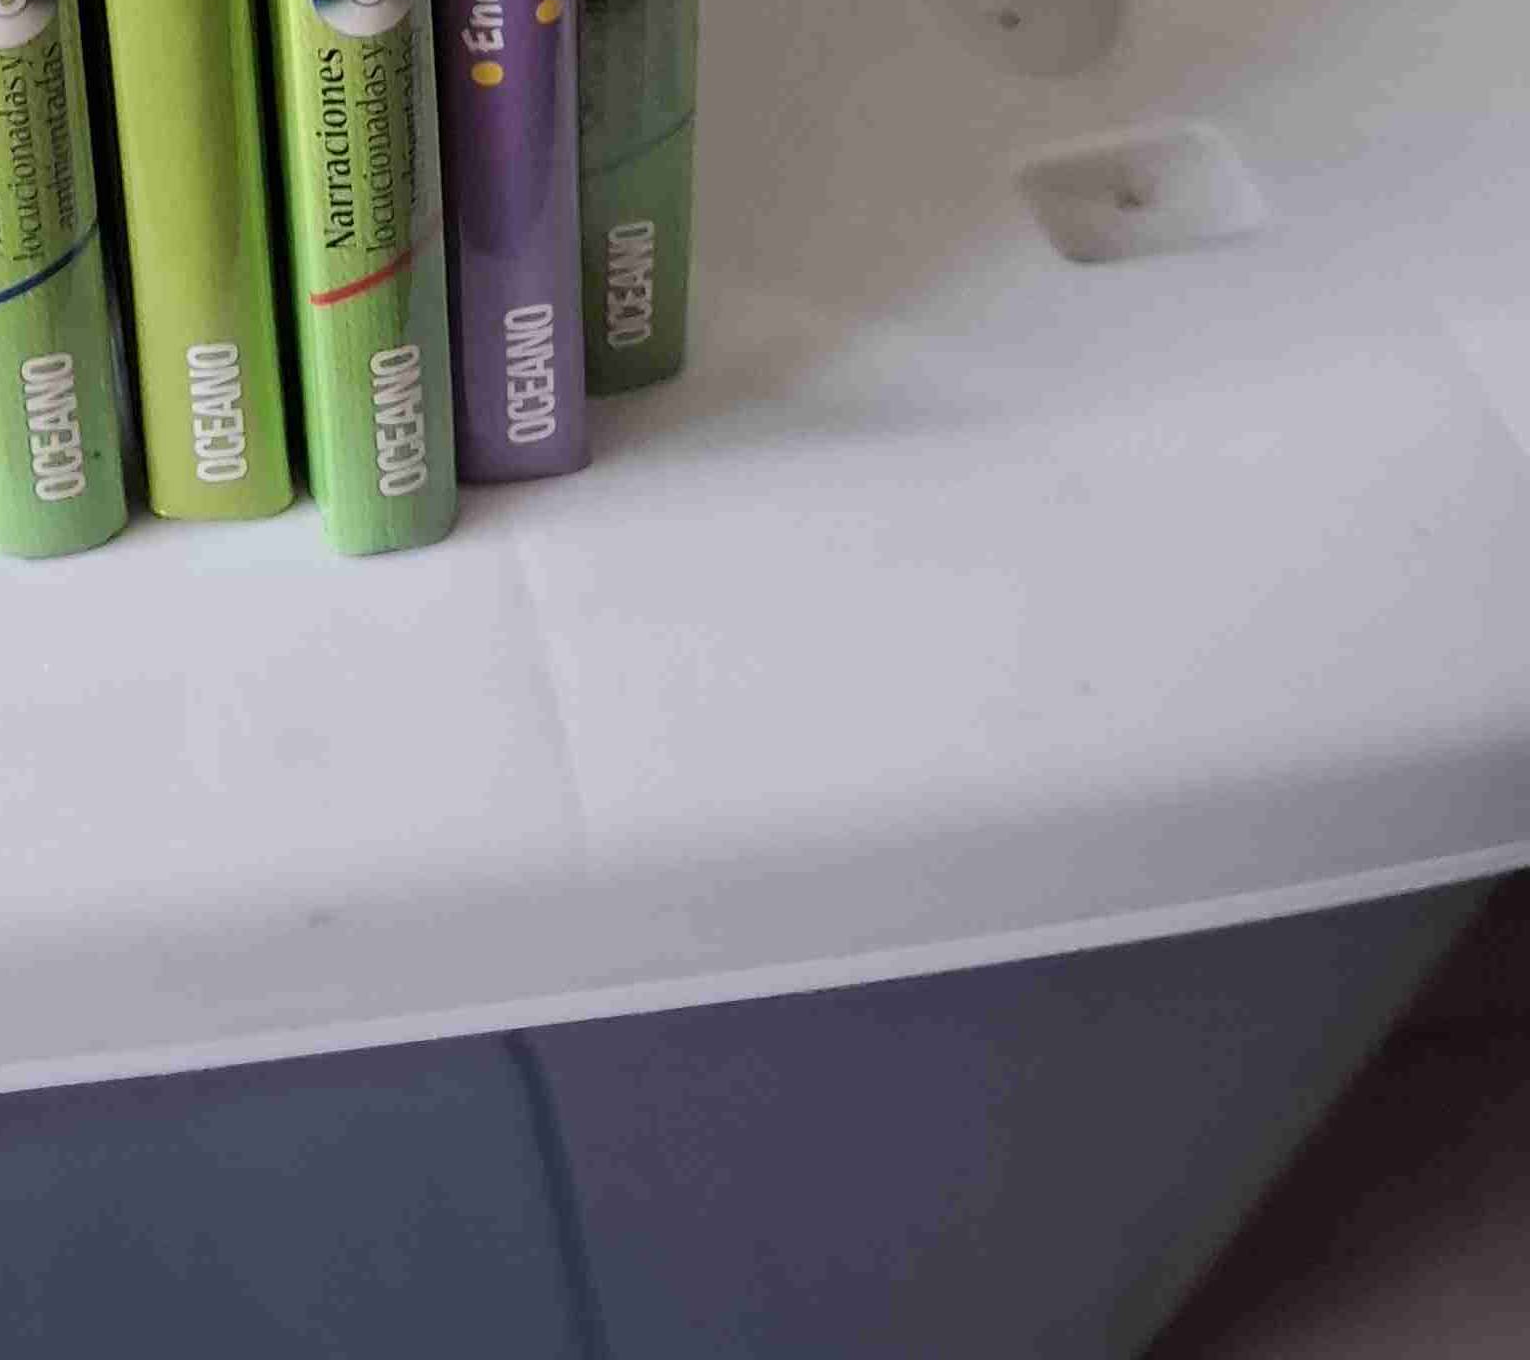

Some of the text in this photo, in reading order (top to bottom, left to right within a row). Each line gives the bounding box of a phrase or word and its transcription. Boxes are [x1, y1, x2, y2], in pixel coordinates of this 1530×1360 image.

[0, 54, 29, 73] y
[315, 48, 357, 251] Narraciones
[355, 43, 396, 254] locucionadas y
[607, 219, 655, 351] OCEANO
[21, 351, 86, 502] OCEANO
[186, 342, 248, 483] OCEANO
[370, 344, 426, 498] OCEANO
[504, 303, 556, 446] OCEANO
